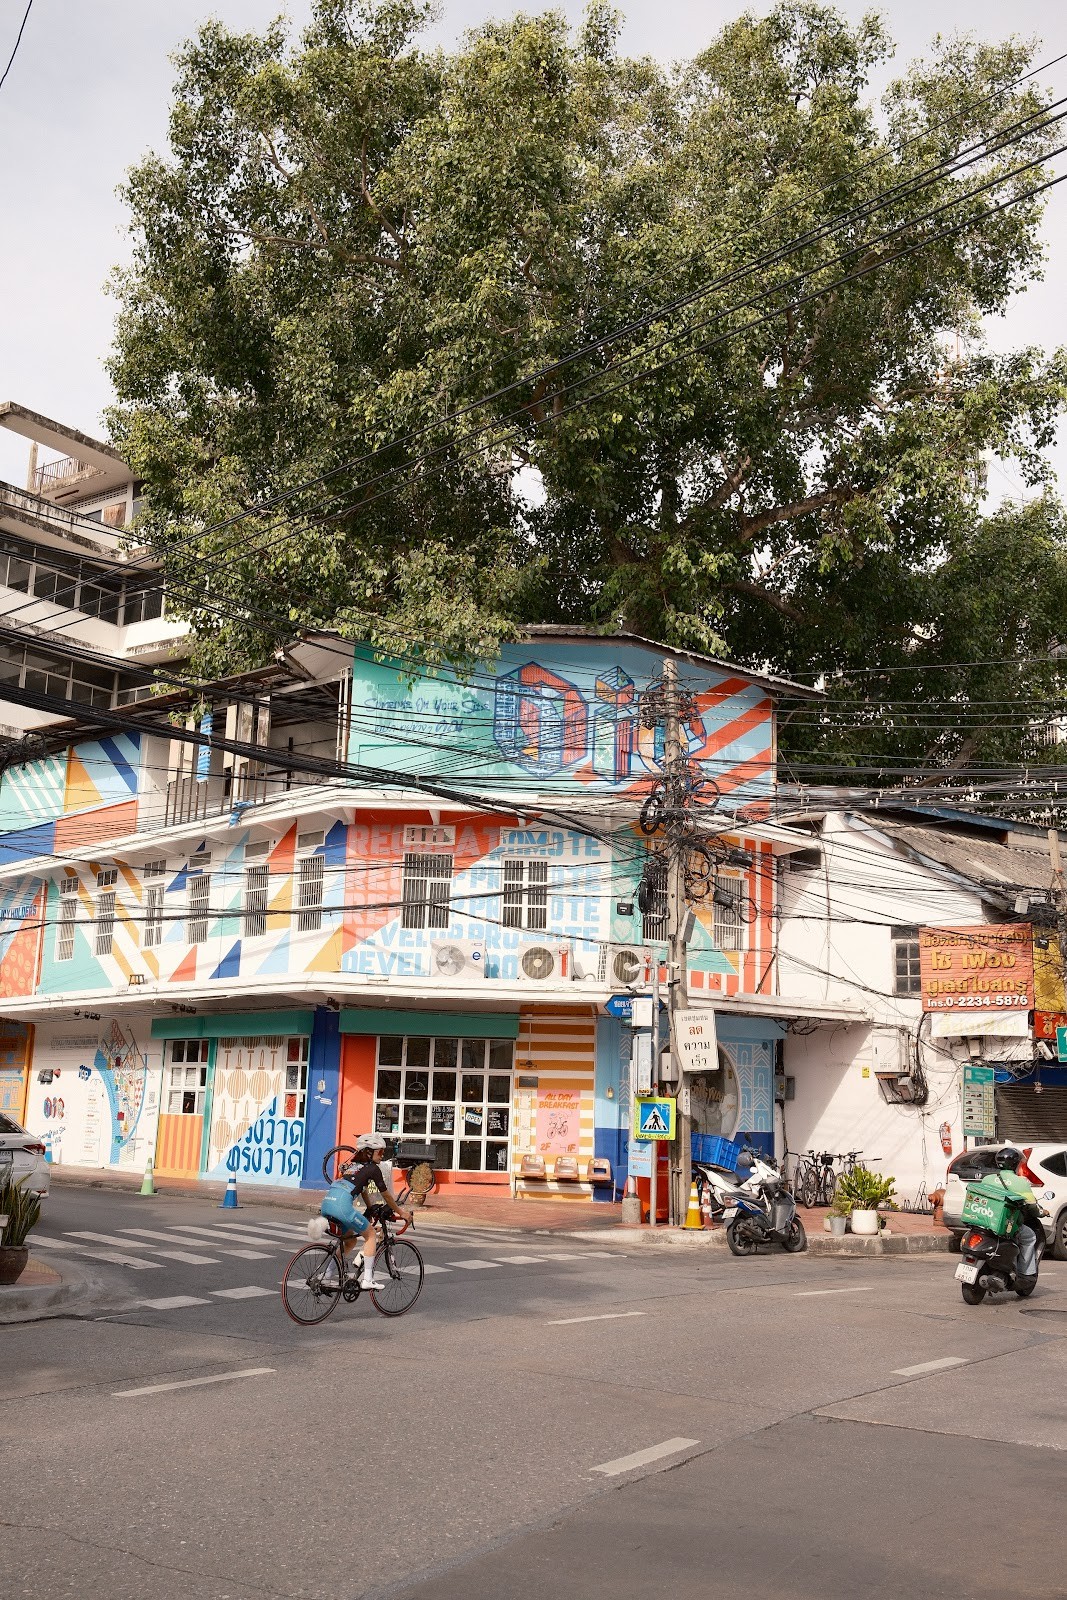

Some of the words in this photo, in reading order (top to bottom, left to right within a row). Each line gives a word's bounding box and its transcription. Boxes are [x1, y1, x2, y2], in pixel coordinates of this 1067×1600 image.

[689, 1026, 703, 1035] ลด
[684, 1042, 711, 1051] ความ
[691, 1054, 708, 1067] เร็ว
[545, 1093, 557, 1101] ALL
[538, 1101, 580, 1110] BREAKFAST
[467, 1114, 481, 1123] OPEN
[971, 1203, 994, 1218] Grab
